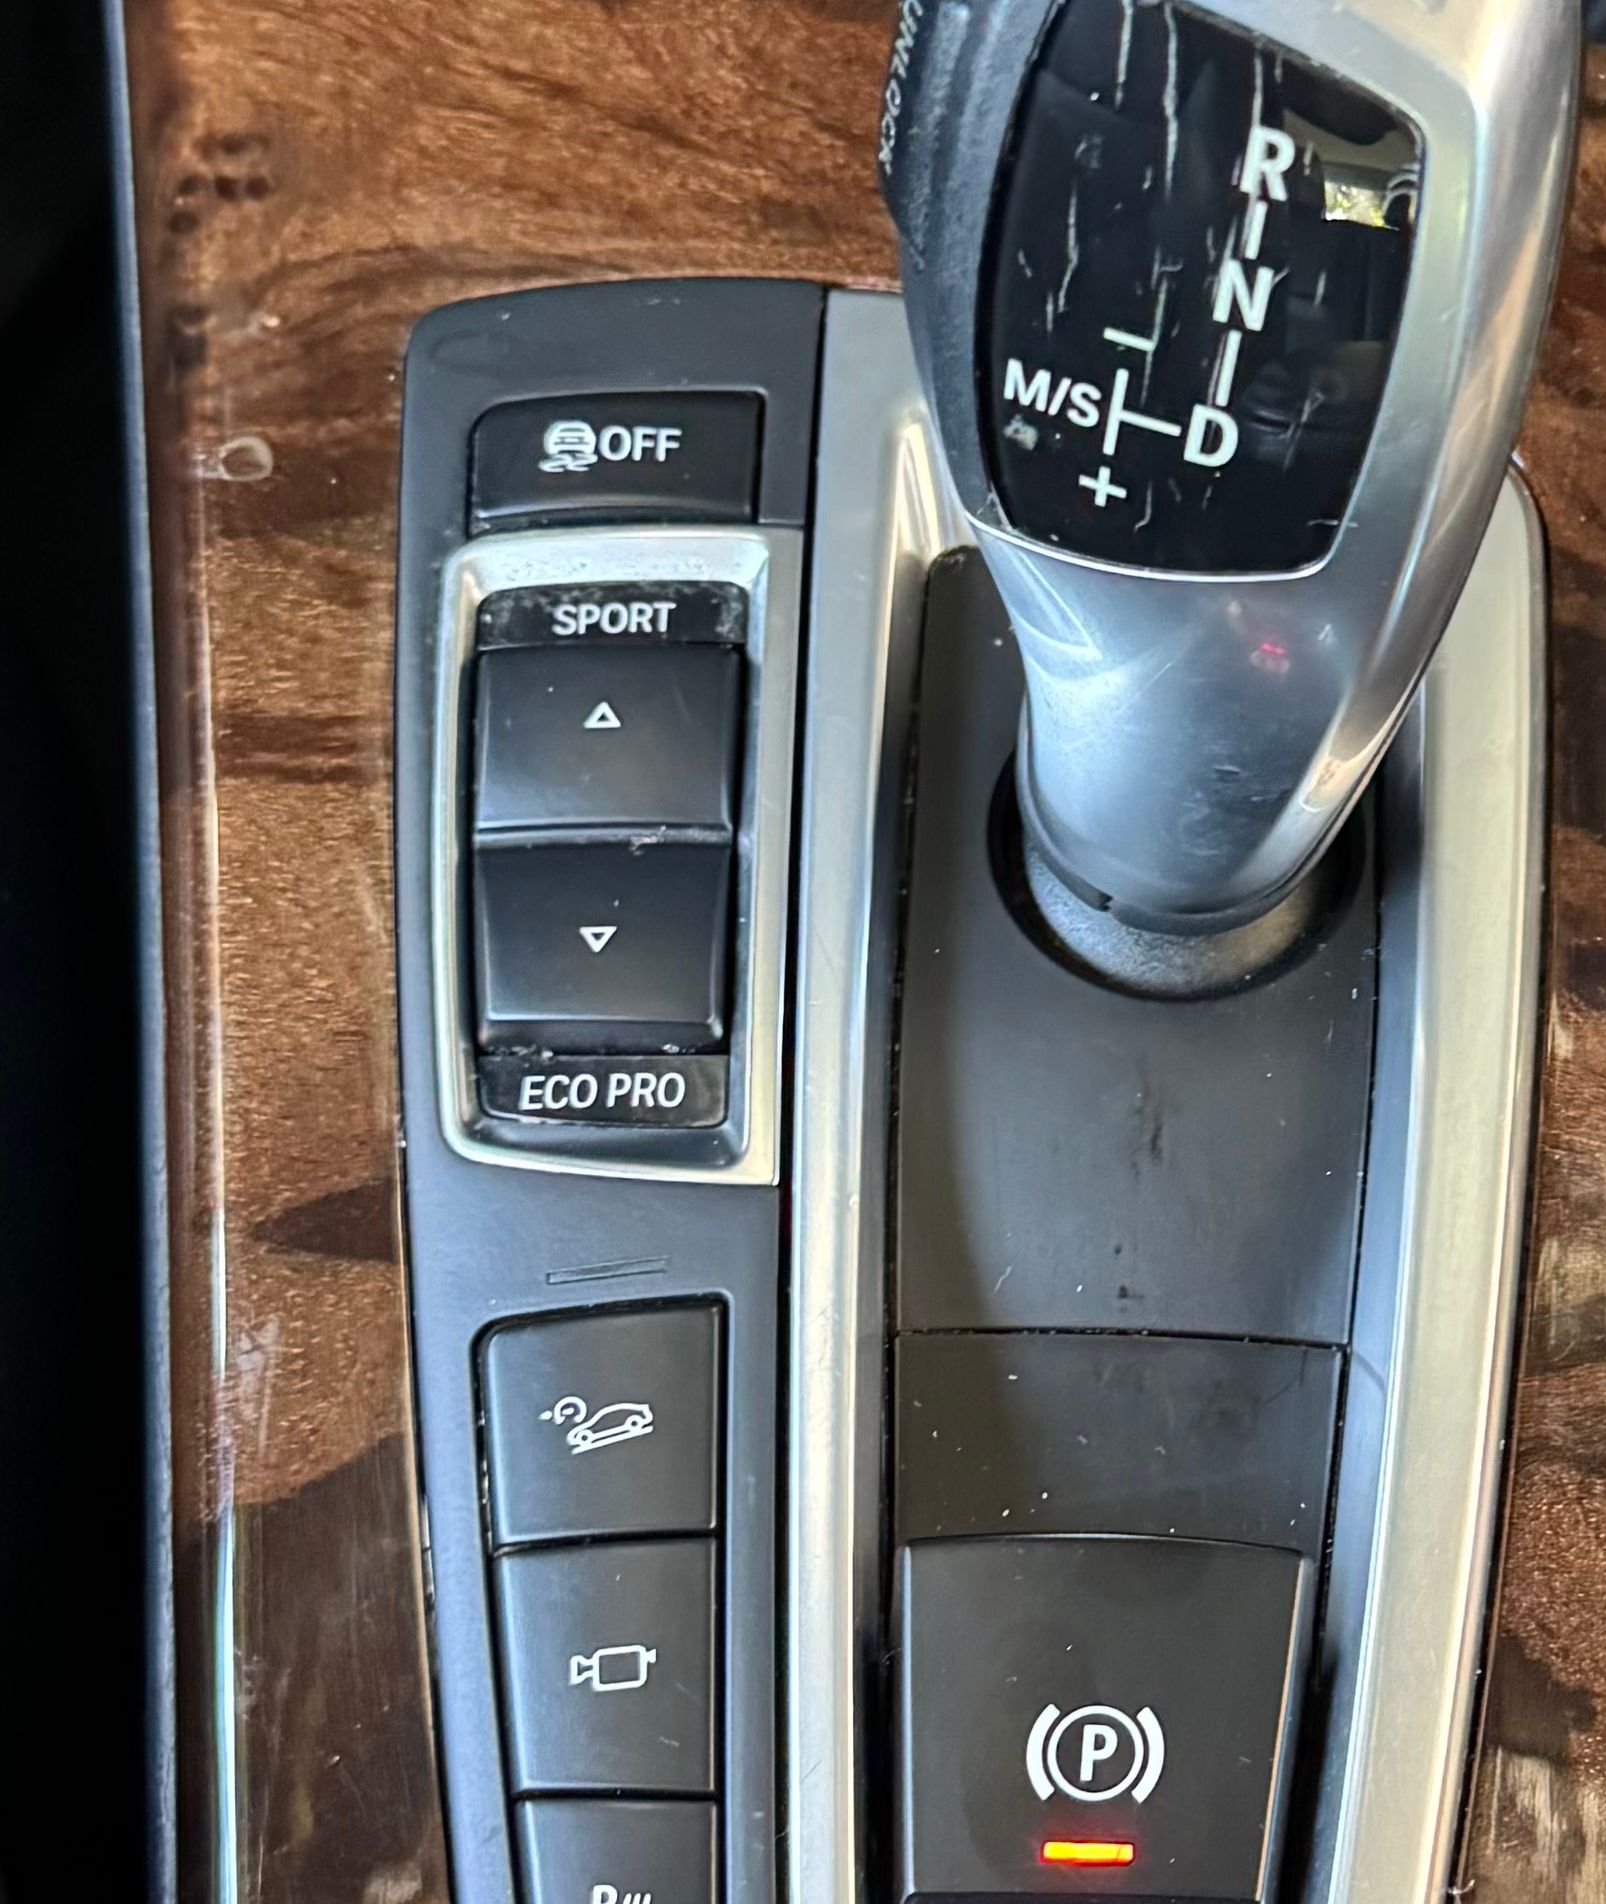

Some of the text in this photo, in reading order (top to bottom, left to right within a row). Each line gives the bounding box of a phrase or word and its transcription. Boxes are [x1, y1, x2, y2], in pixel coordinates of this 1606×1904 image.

[1239, 124, 1296, 202] R
[1212, 259, 1275, 332] N
[1003, 357, 1102, 429] M/S
[599, 425, 683, 463] OFF
[1183, 403, 1240, 468] D
[551, 601, 677, 637] SPORT
[519, 1071, 687, 1111] ECO PRO
